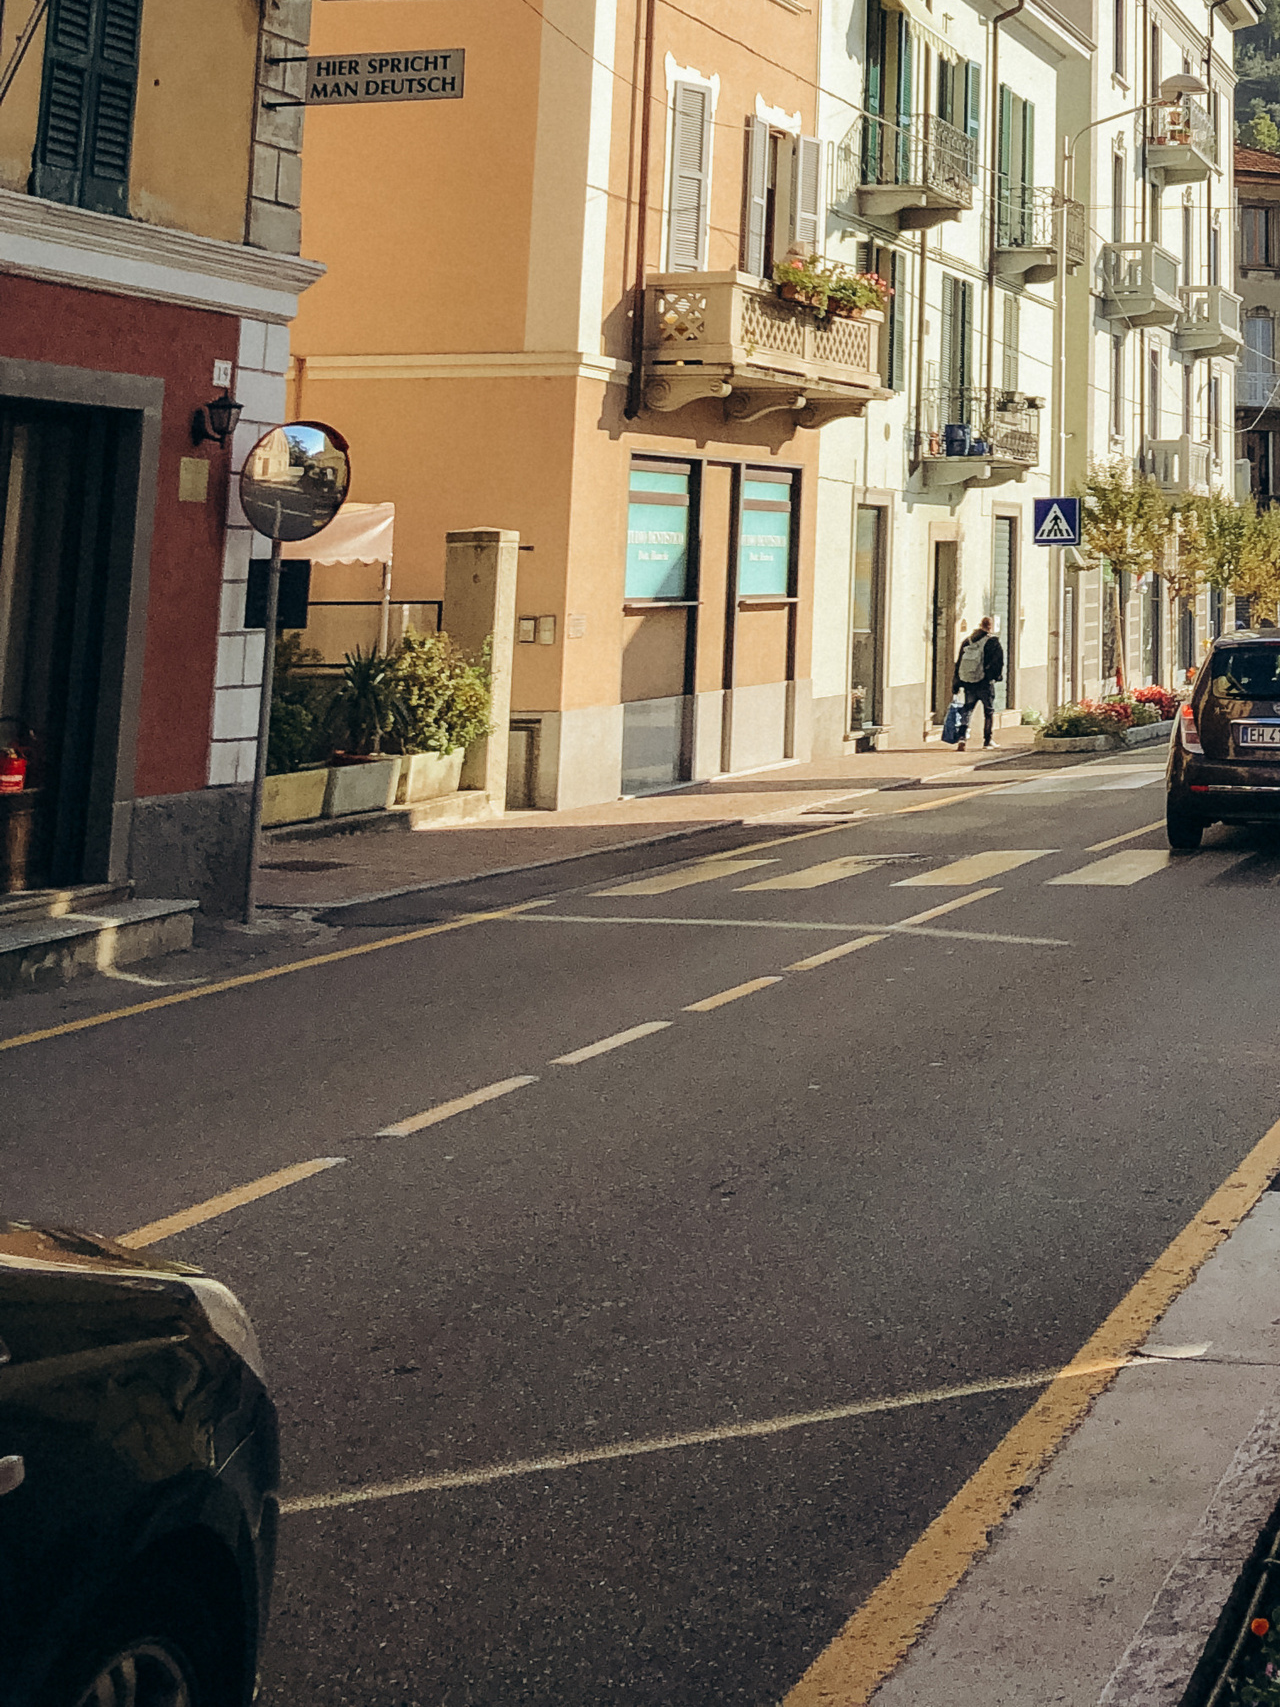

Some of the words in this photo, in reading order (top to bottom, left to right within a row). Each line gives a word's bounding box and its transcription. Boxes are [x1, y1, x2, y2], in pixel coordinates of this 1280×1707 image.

[316, 59, 360, 77] HIER
[367, 54, 451, 74] SPRICHT
[310, 81, 358, 99] MAN
[365, 76, 456, 96] DEUTSCH
[1249, 728, 1265, 742] EH
